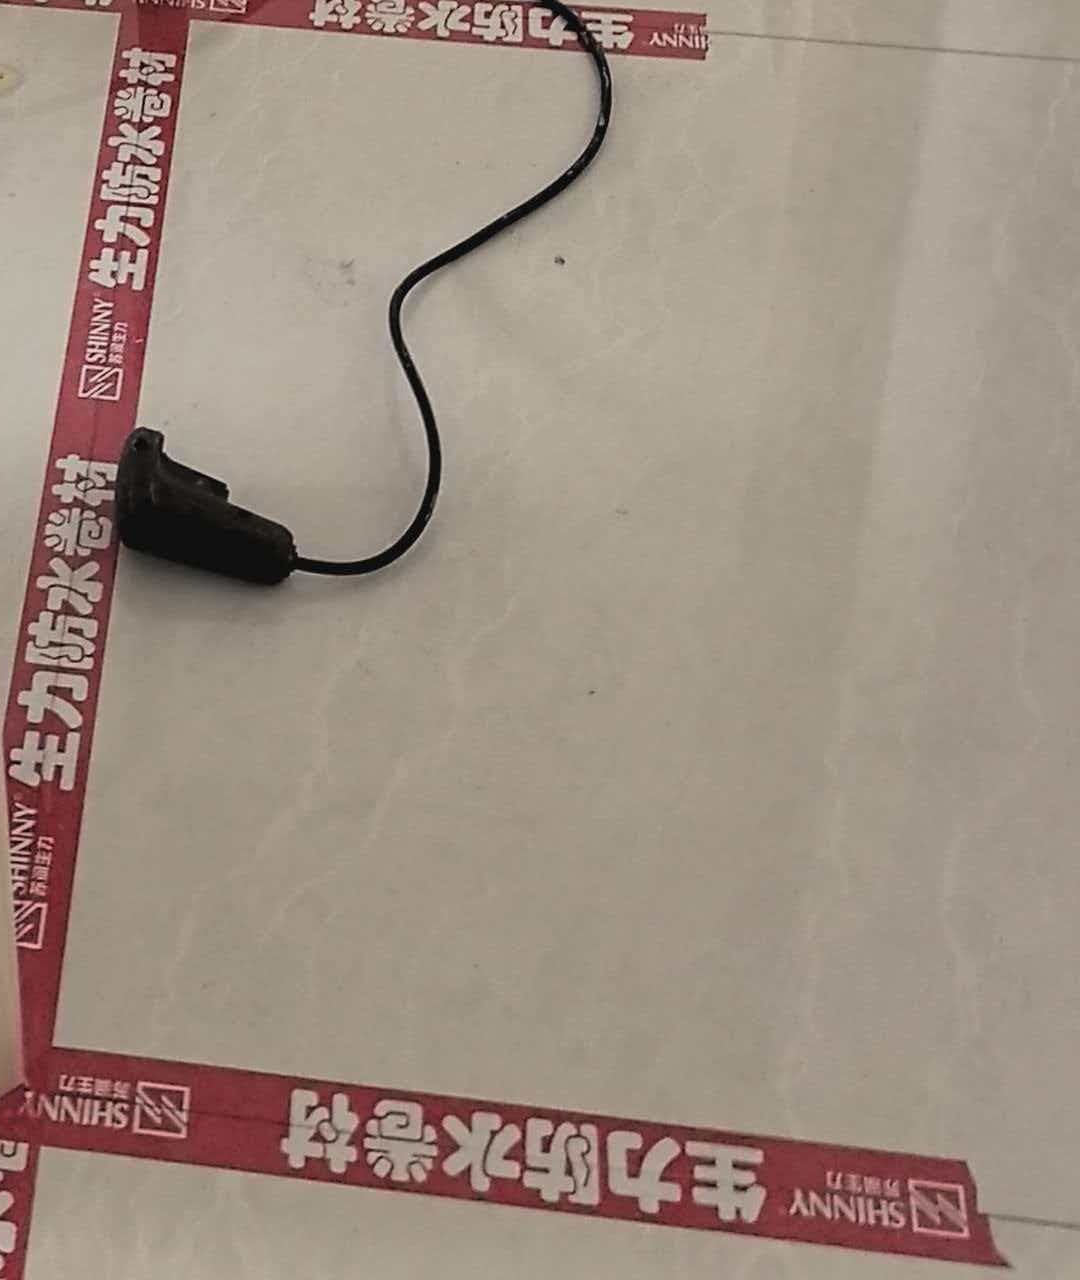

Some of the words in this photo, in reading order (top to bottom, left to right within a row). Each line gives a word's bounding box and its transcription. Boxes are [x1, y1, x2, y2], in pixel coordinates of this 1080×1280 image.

[87, 46, 177, 292] 生力防水卷材
[86, 297, 115, 364] SHINNY
[8, 453, 119, 791] 生力防水卷材
[280, 1087, 765, 1224] 生力防水卷材
[788, 1187, 907, 1230] SHINNY
